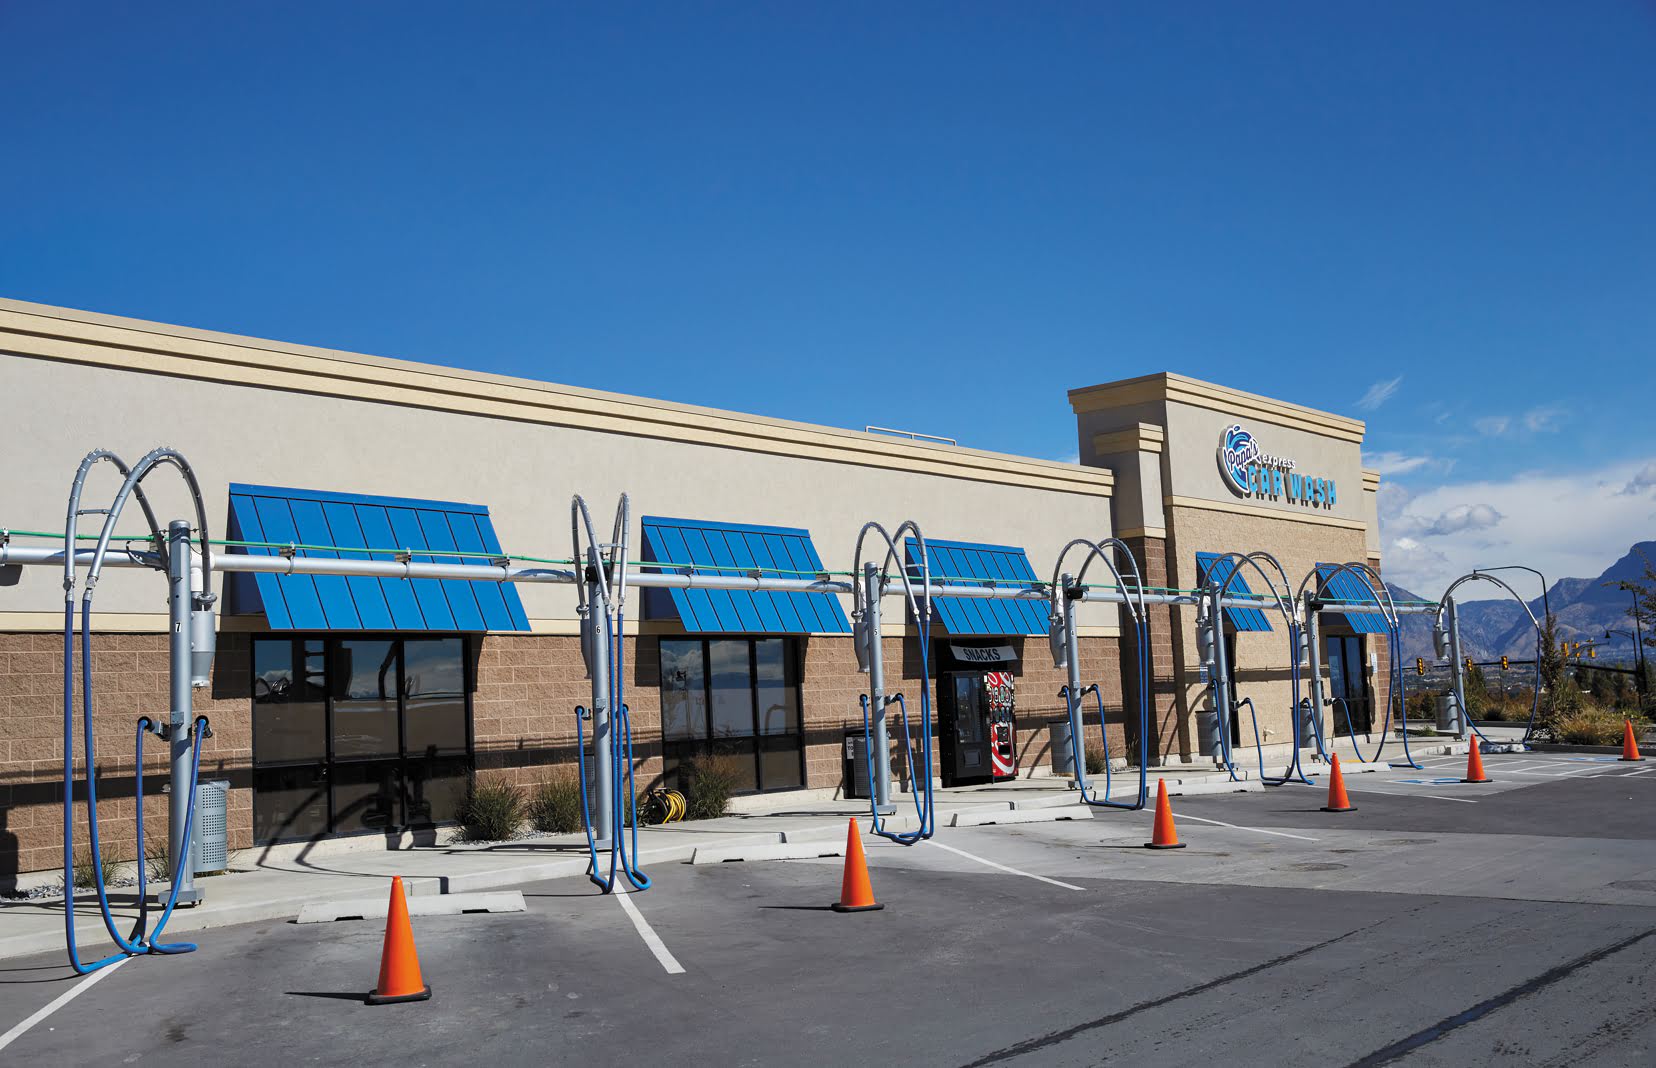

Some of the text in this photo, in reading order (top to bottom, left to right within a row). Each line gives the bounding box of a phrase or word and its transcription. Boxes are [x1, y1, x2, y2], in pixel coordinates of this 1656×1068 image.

[1226, 439, 1259, 472] Papa's
[1262, 454, 1296, 470] express
[1247, 465, 1337, 505] CAR WASH
[963, 648, 1001, 661] SNACKS
